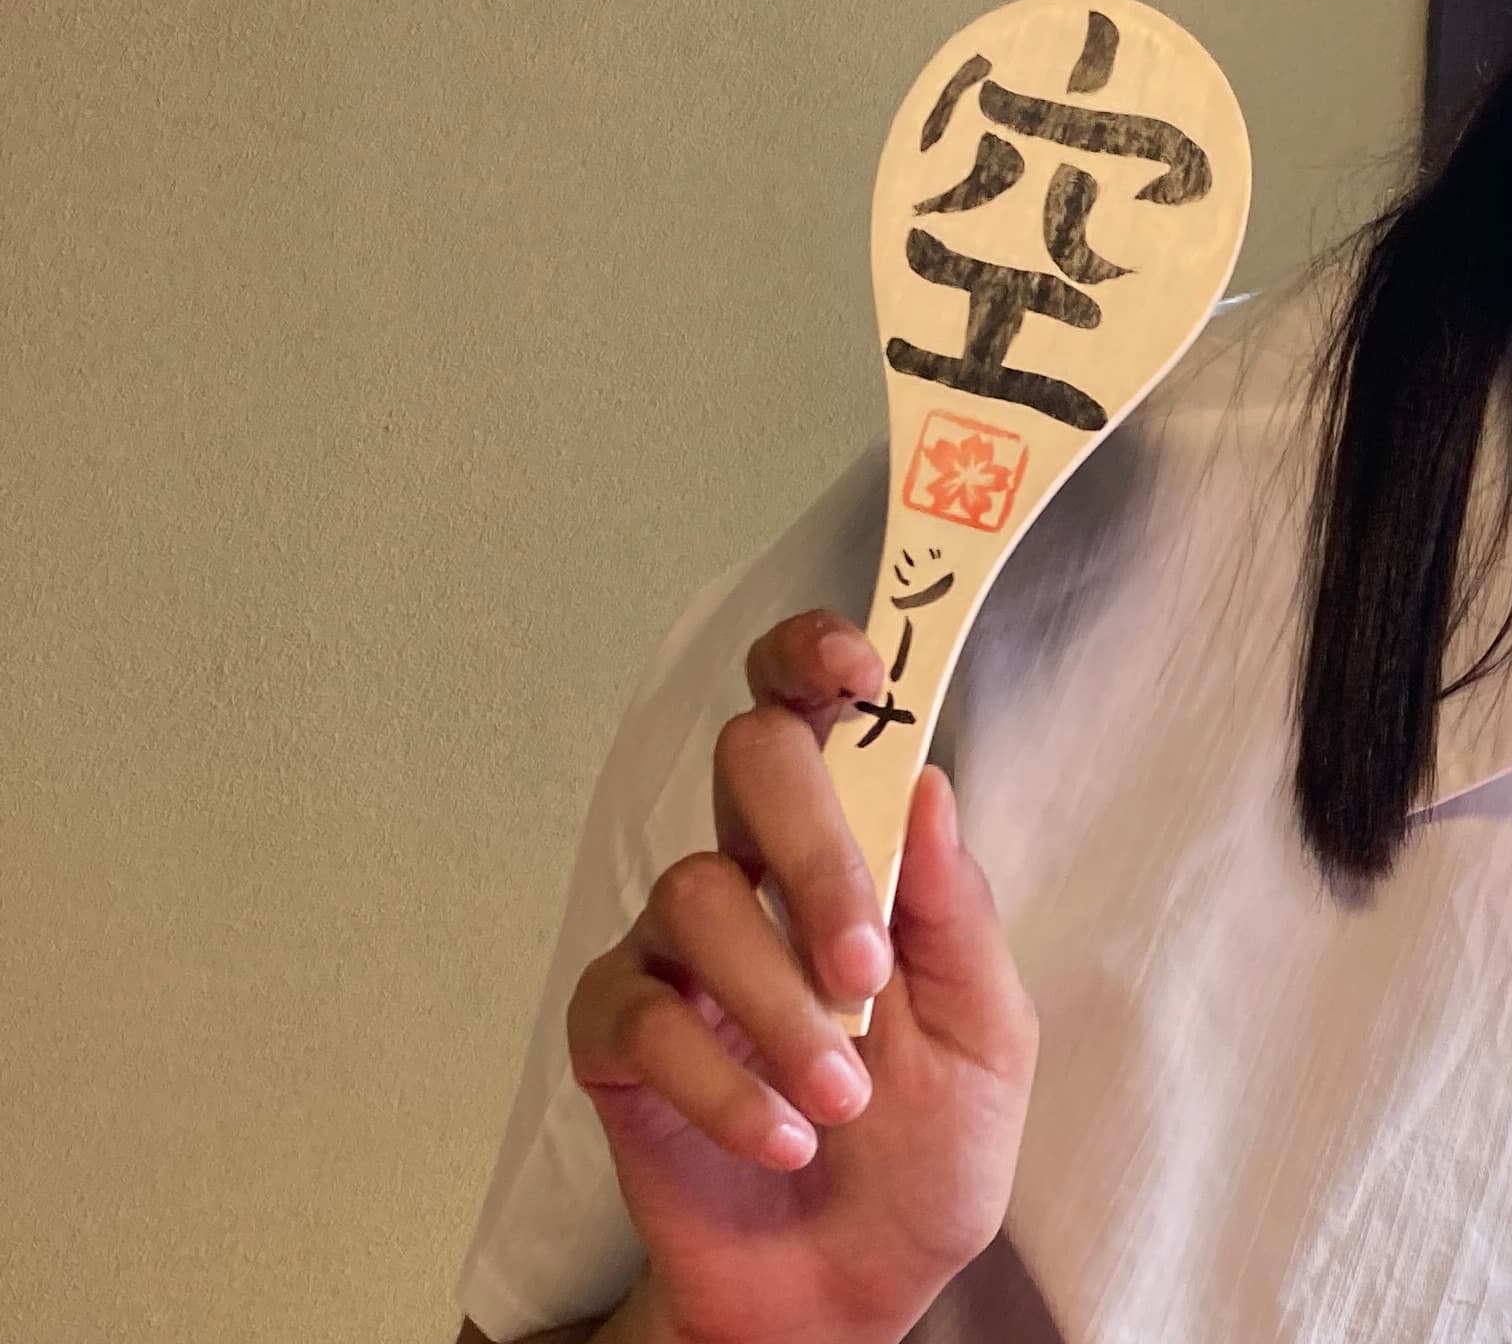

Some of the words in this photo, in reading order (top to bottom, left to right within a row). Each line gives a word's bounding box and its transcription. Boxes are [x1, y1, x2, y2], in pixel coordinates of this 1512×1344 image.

[886, 10, 1213, 431] 空
[855, 547, 955, 748] ジーナ
